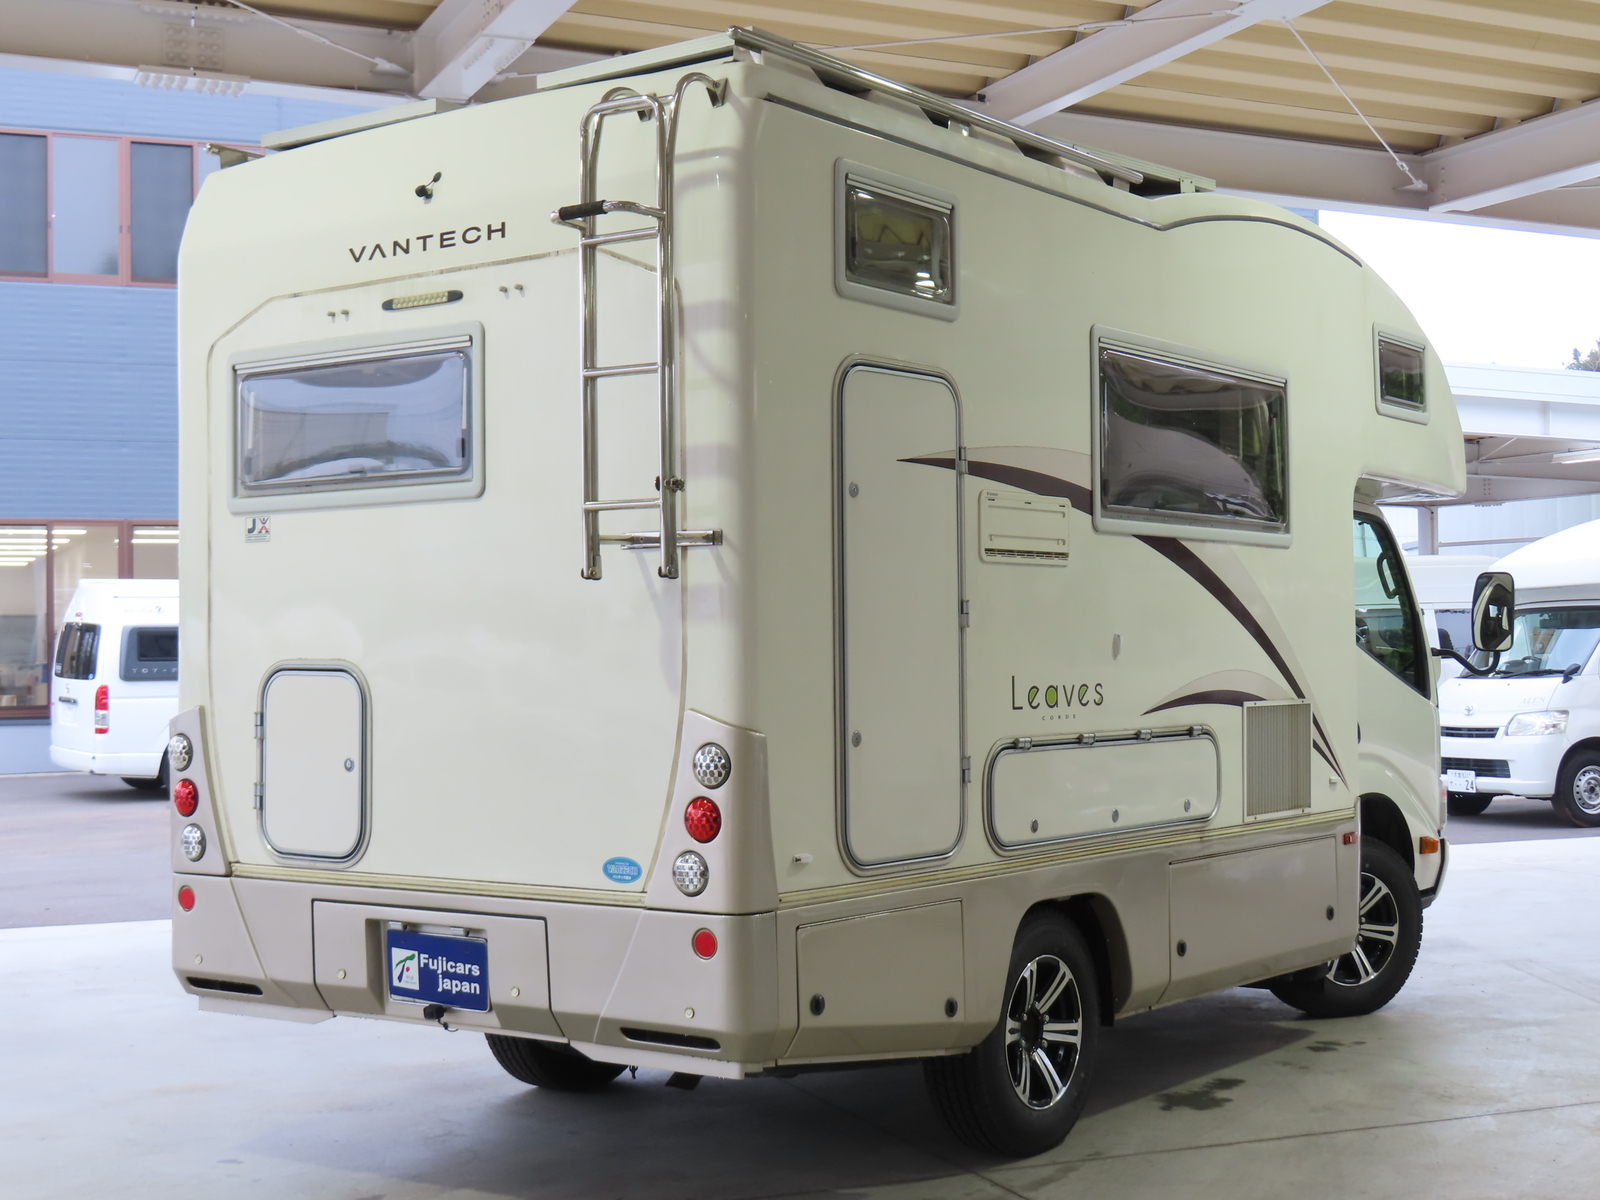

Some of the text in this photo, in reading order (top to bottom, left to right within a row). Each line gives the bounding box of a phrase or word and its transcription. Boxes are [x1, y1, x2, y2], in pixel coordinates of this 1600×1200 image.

[348, 221, 506, 263] VANTECH
[1011, 675, 1104, 710] Leaves
[420, 953, 480, 976] Fujicars
[437, 974, 480, 995] japan
